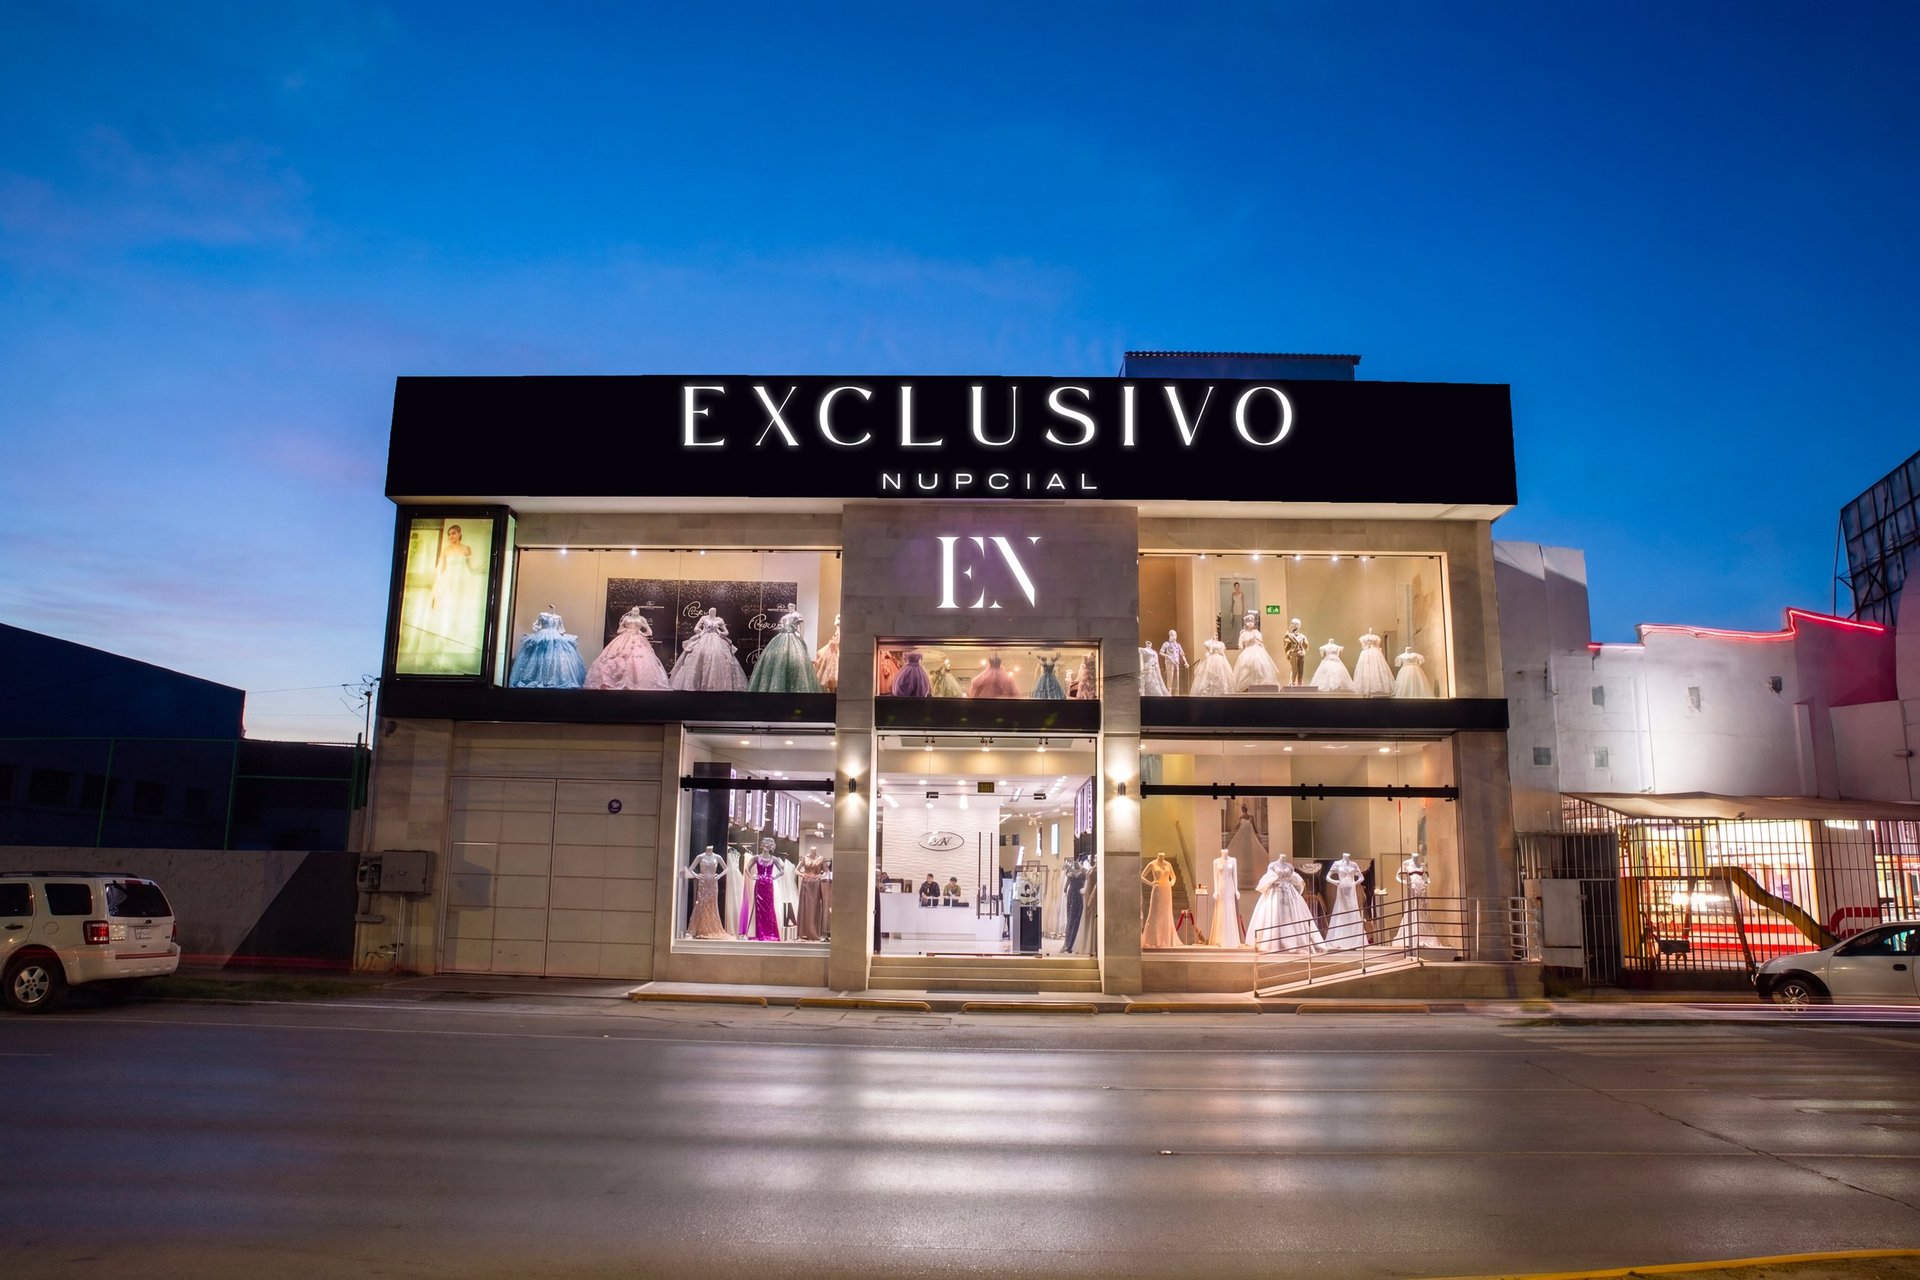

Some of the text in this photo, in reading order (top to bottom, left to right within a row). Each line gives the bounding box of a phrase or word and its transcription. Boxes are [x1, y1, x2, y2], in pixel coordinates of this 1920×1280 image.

[683, 385, 1293, 447] EXCLUSIVO
[882, 472, 1097, 489] NUPCIAL
[936, 536, 1042, 609] EN
